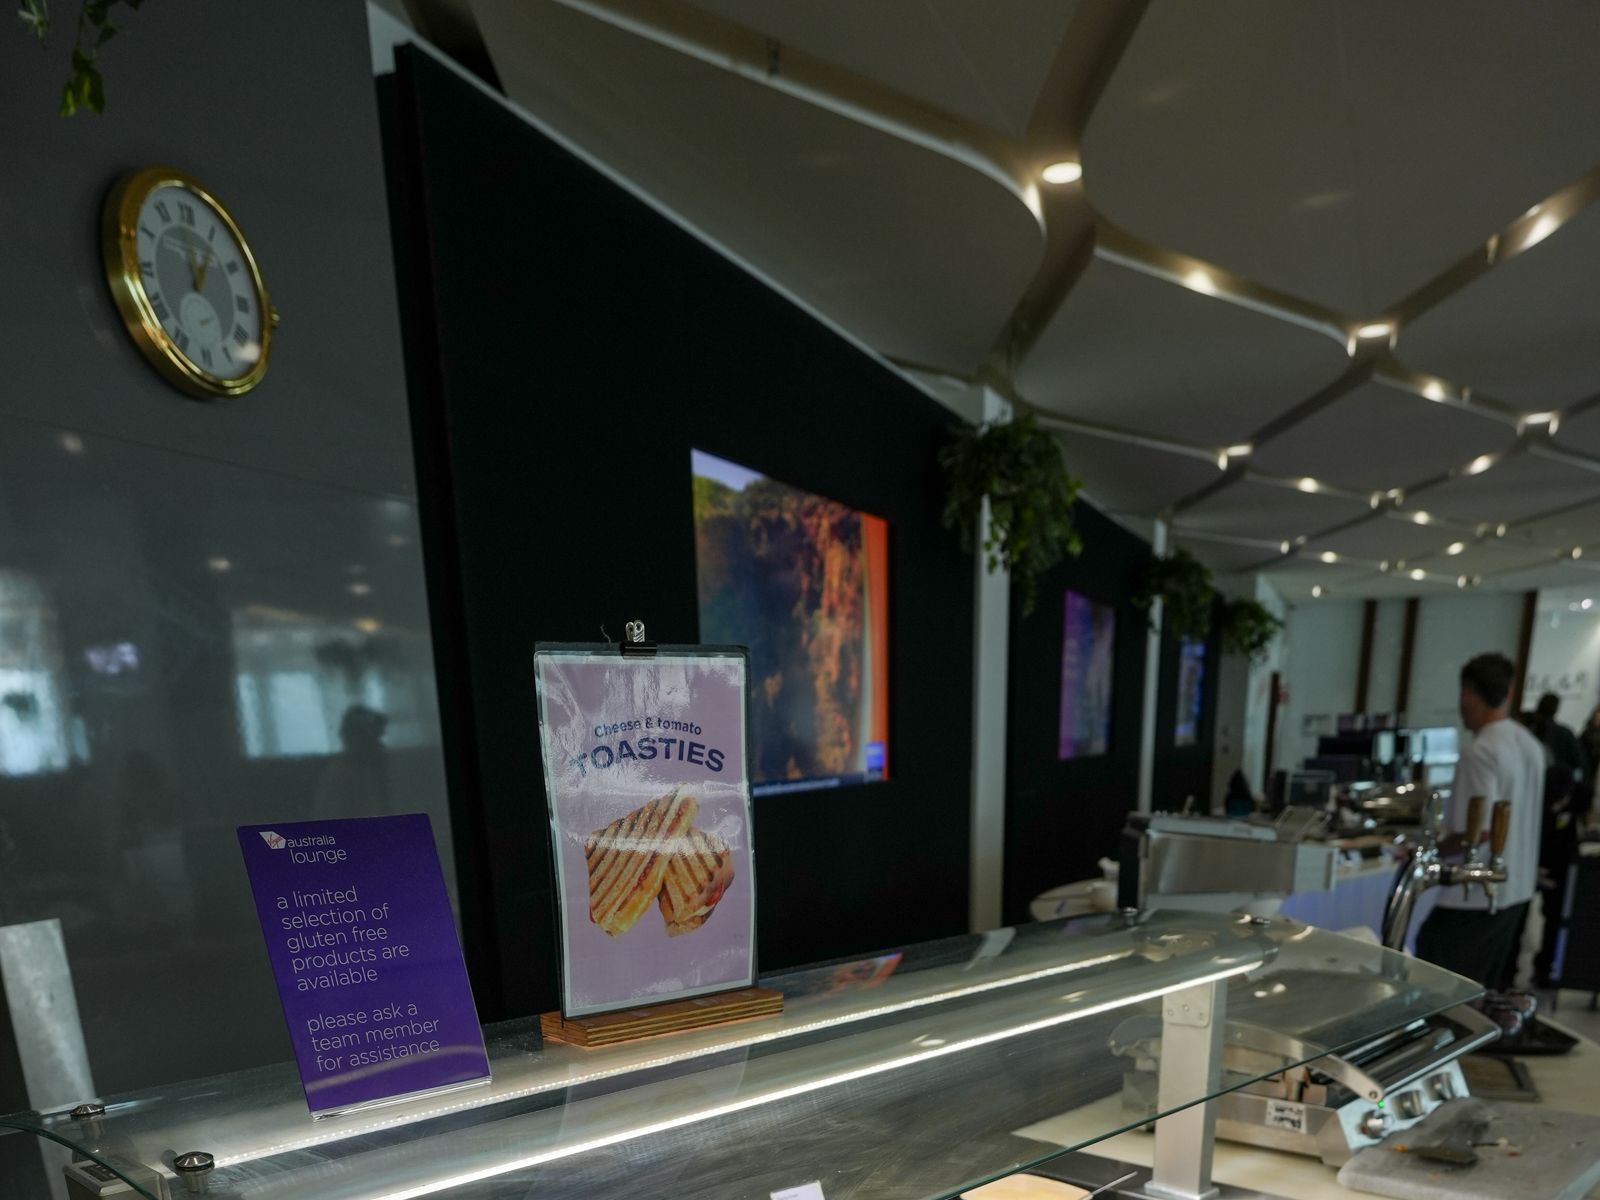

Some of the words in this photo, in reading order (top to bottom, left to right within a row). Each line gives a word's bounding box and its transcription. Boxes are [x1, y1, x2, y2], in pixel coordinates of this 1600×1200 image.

[594, 719, 642, 738] Cheese
[645, 717, 654, 729] &
[657, 717, 702, 736] tomato
[569, 736, 726, 778] TOASTIES
[287, 834, 337, 848] australia
[289, 849, 348, 864] lounge
[277, 896, 289, 910] a
[293, 886, 358, 908] limited
[281, 907, 366, 930] selection
[371, 903, 390, 920] of
[287, 930, 347, 953] gluten
[351, 925, 388, 942] free
[292, 947, 377, 974] products
[382, 945, 410, 960] are
[297, 966, 378, 992] available
[307, 1012, 367, 1035] please
[372, 1002, 402, 1020] ask
[407, 1002, 418, 1016] a
[311, 1033, 360, 1052] team
[365, 1018, 440, 1043] member
[316, 1055, 343, 1072] for
[349, 1038, 440, 1067] assistance
